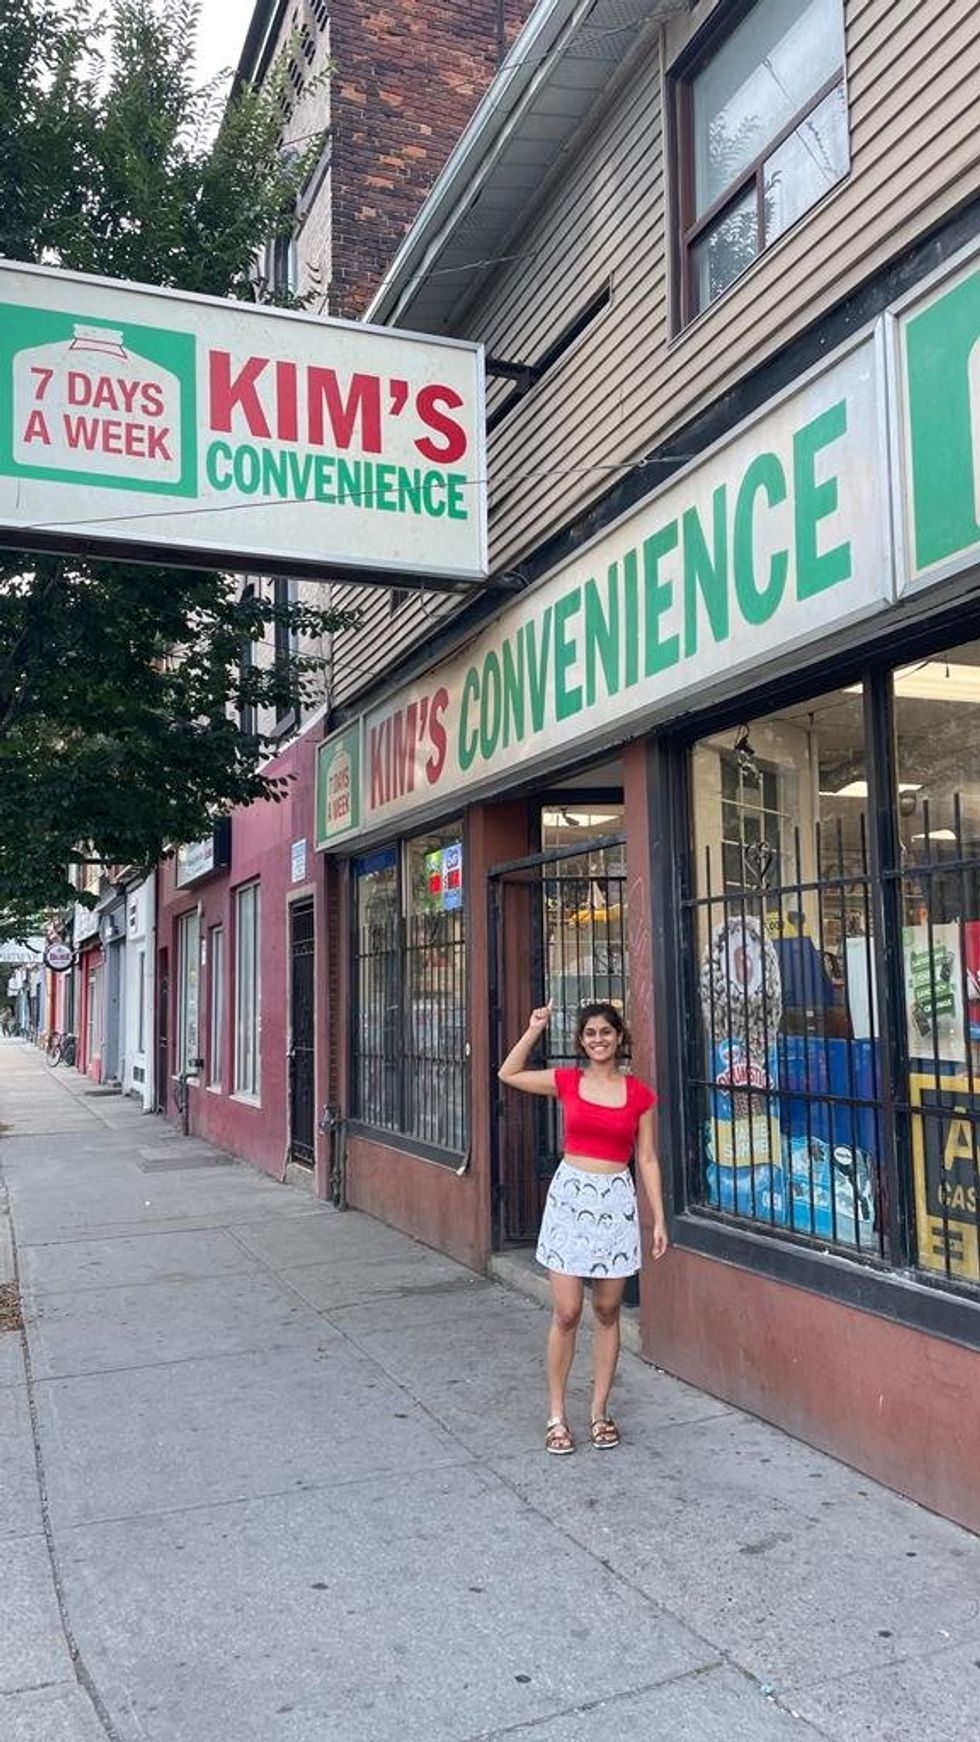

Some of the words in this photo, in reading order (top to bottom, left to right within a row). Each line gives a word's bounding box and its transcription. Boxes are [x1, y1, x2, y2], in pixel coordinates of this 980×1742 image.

[30, 367, 54, 400] 7
[67, 370, 164, 417] DAYS
[208, 350, 468, 464] KIM'S
[23, 410, 52, 446] A
[63, 413, 172, 461] WEEK
[206, 440, 468, 520] CONVENIENCE
[370, 687, 449, 810] KIM'S
[457, 399, 852, 772] CONVENIENCE
